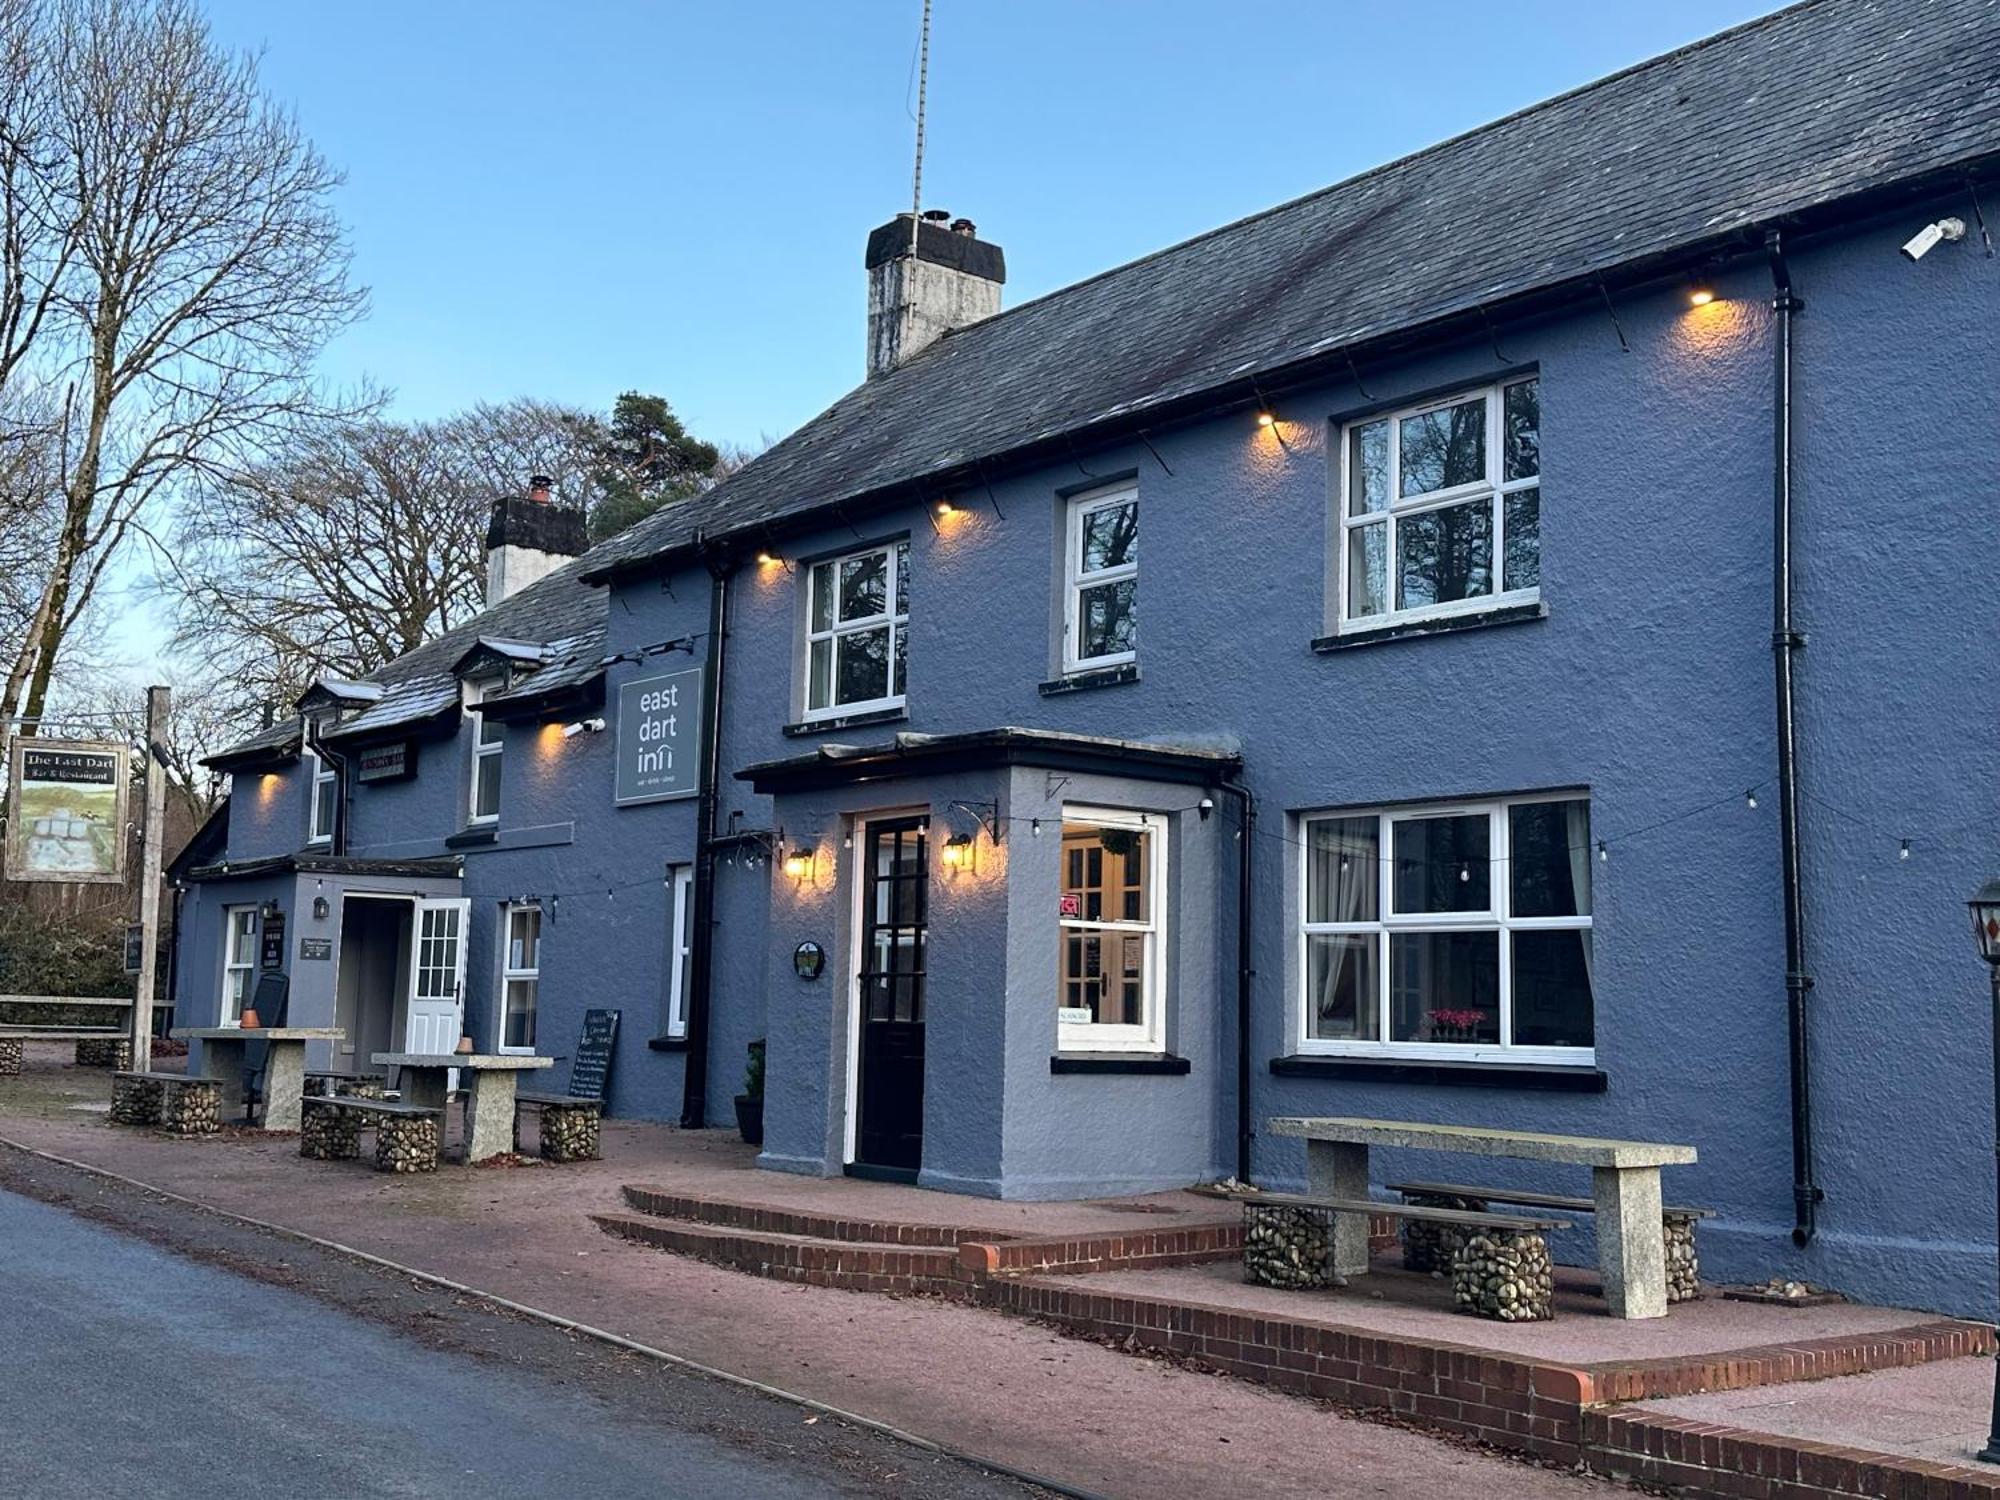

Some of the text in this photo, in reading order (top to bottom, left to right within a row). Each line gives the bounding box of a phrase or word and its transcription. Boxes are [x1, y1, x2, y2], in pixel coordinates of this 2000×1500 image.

[641, 684, 678, 712] east
[639, 714, 677, 742] dart
[28, 755, 51, 765] The
[86, 758, 113, 769] Dart
[638, 744, 673, 773] inn
